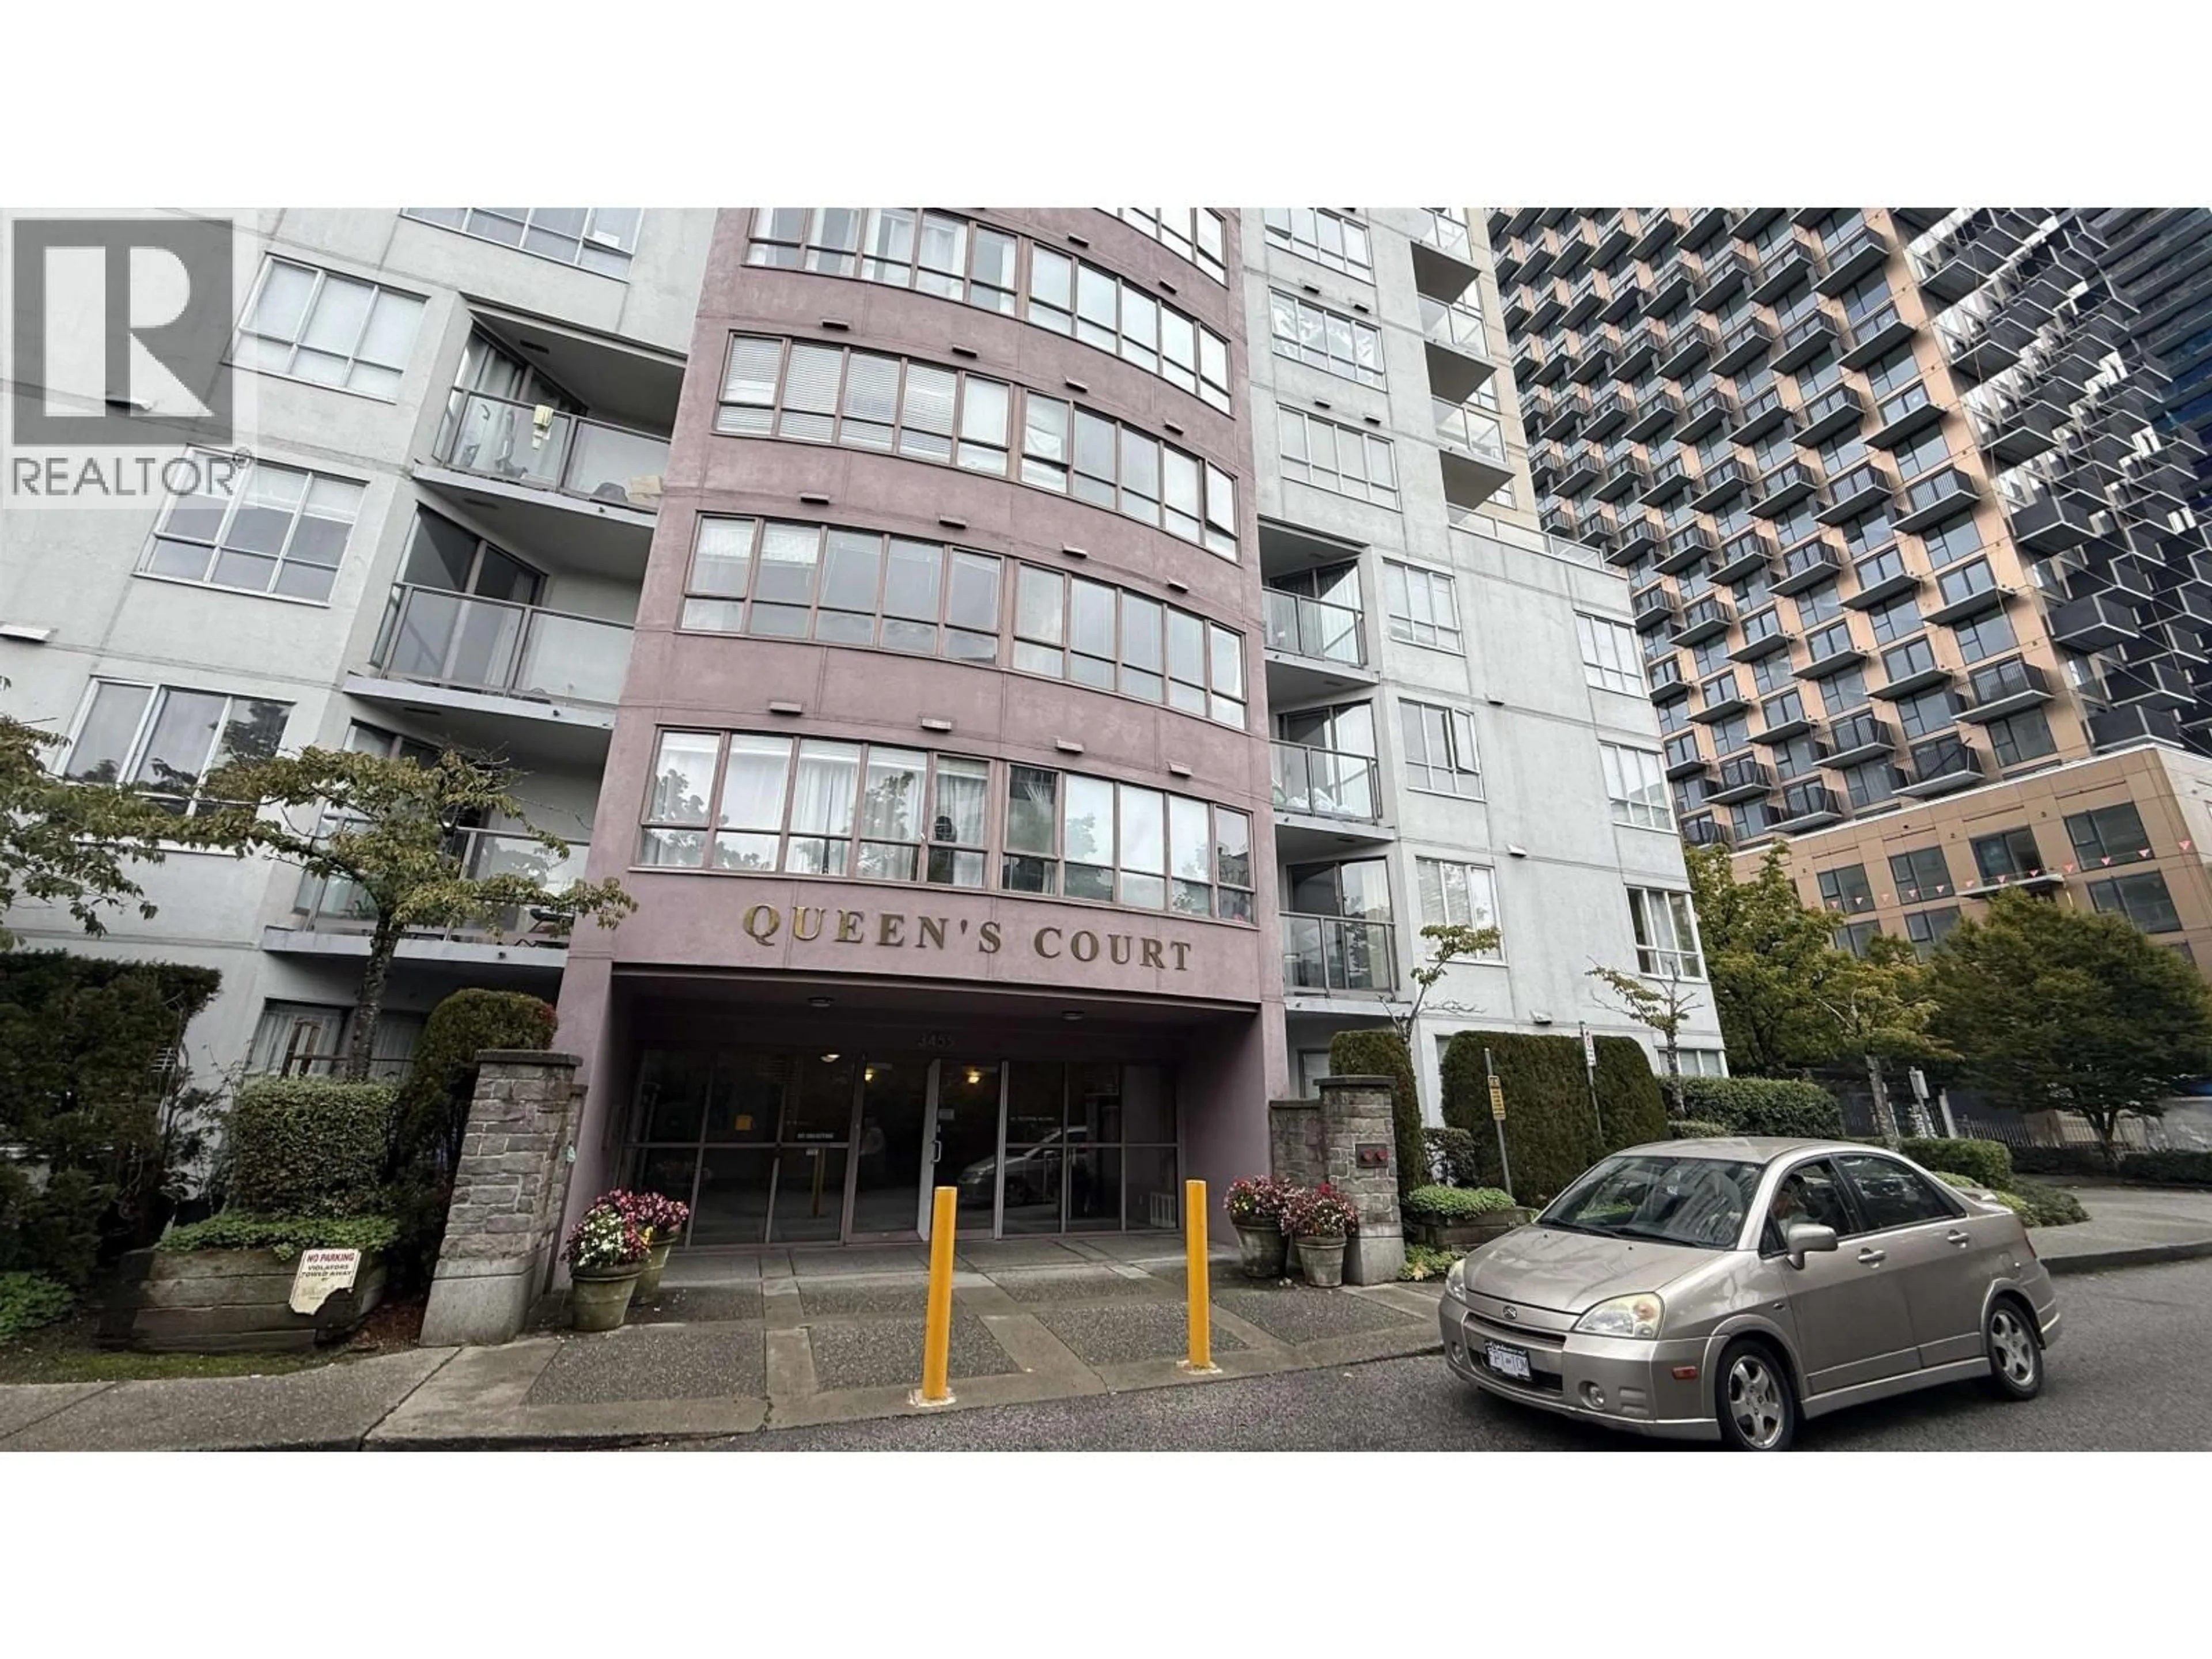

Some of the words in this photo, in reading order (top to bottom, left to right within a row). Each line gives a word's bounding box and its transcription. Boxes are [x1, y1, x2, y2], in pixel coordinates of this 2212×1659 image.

[743, 904, 1001, 955] QUEEN'S
[1034, 927, 1192, 972] COURT
[306, 1253, 319, 1262] NO
[320, 1252, 355, 1262] PARKING
